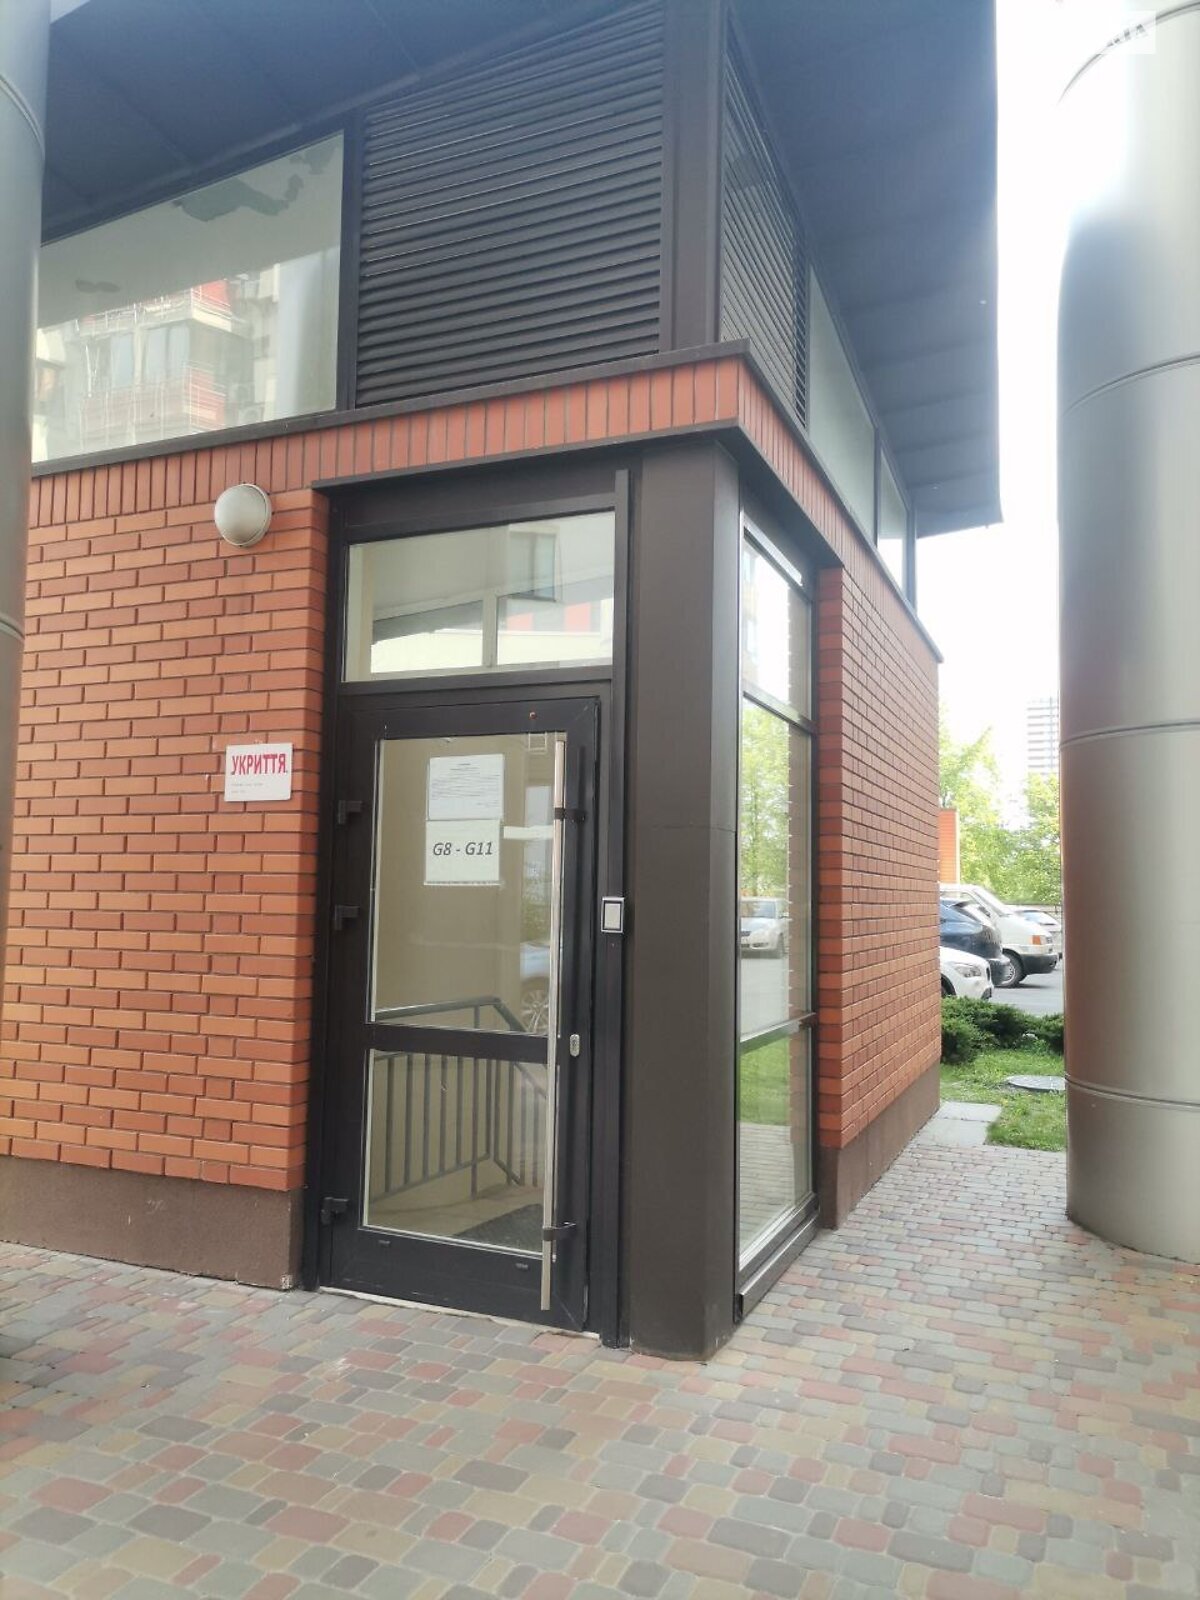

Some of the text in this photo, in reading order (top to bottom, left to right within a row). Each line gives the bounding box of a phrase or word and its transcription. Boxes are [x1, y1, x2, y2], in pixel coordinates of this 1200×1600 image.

[231, 753, 287, 775] УКРИТТЯ
[433, 842, 452, 856] G8
[465, 841, 493, 856] G11
